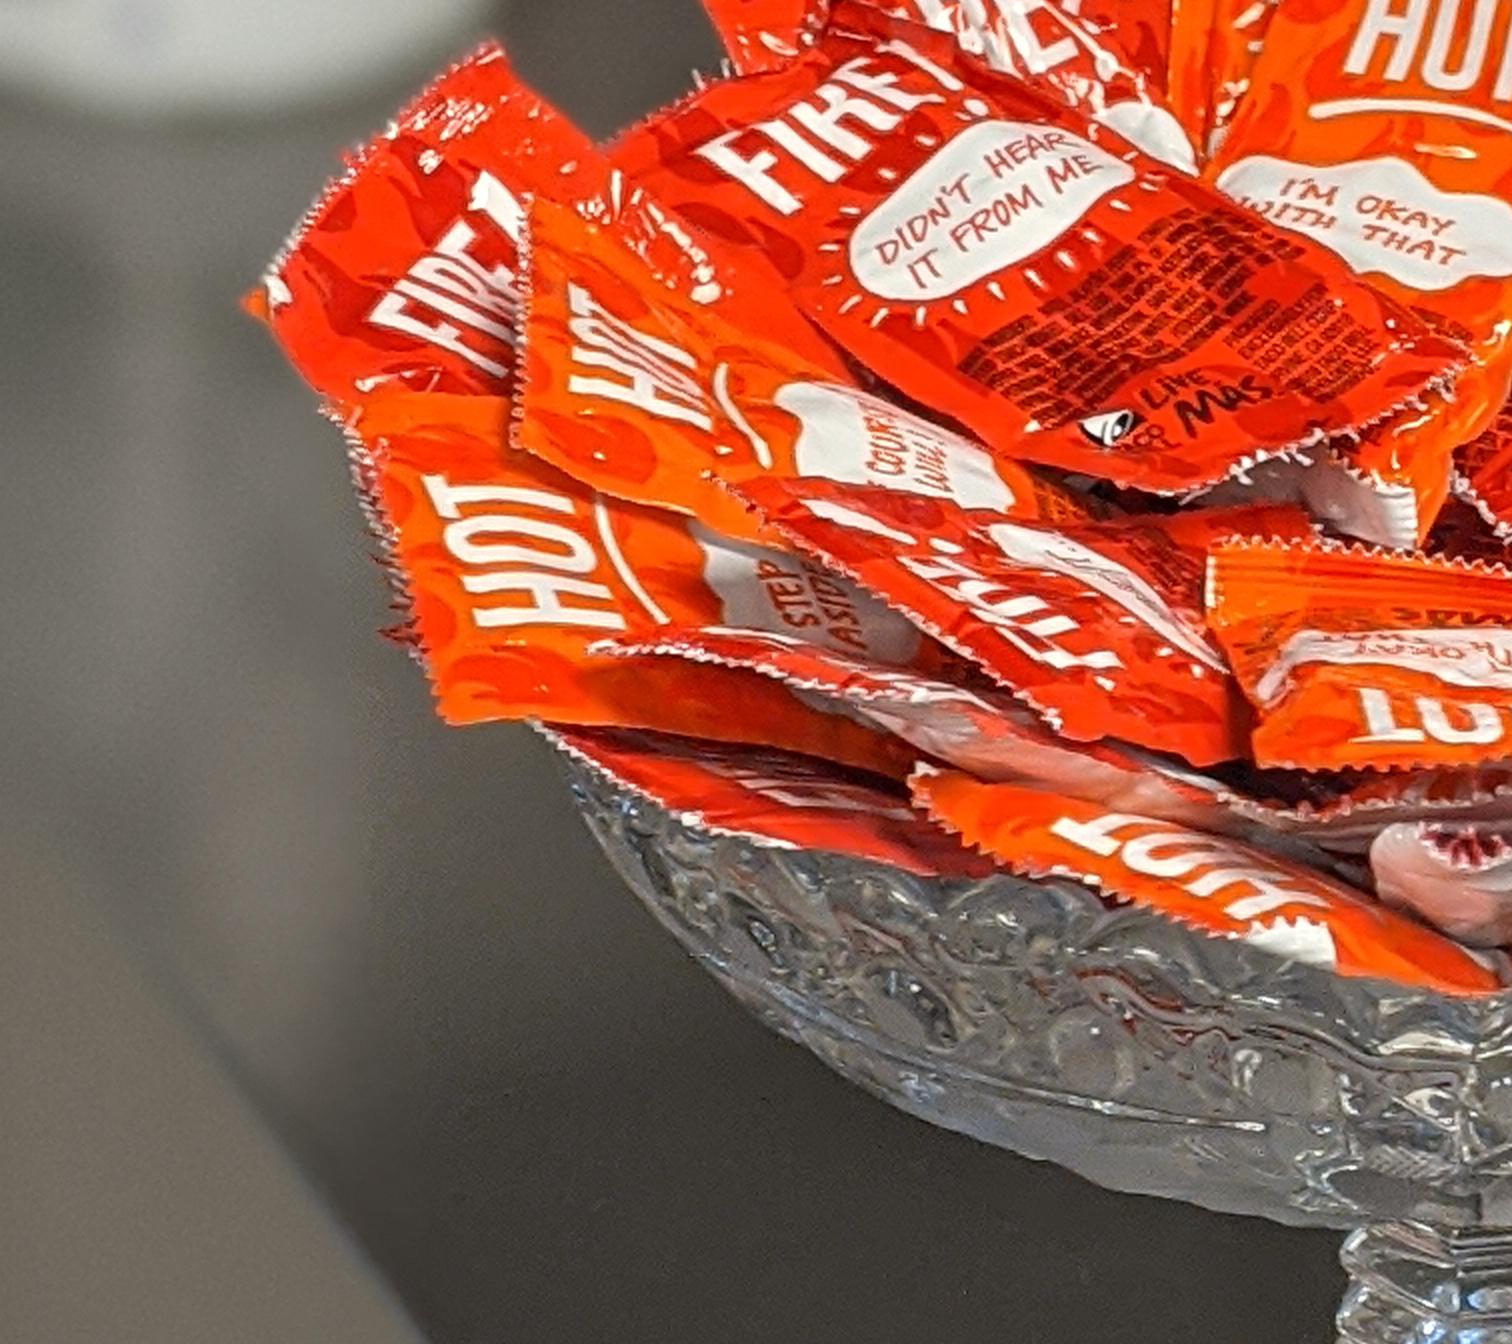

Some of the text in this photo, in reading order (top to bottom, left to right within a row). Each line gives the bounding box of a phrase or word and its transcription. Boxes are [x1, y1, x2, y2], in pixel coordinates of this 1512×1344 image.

[874, 130, 1085, 265] DIDN'T HEAR
[906, 154, 1104, 290] IT FROM ME
[1234, 194, 1468, 266] WITH THAT
[1280, 177, 1457, 237] I'M OKAY
[566, 280, 714, 433] HOT
[420, 473, 626, 630] HOT
[756, 558, 821, 630] STEP
